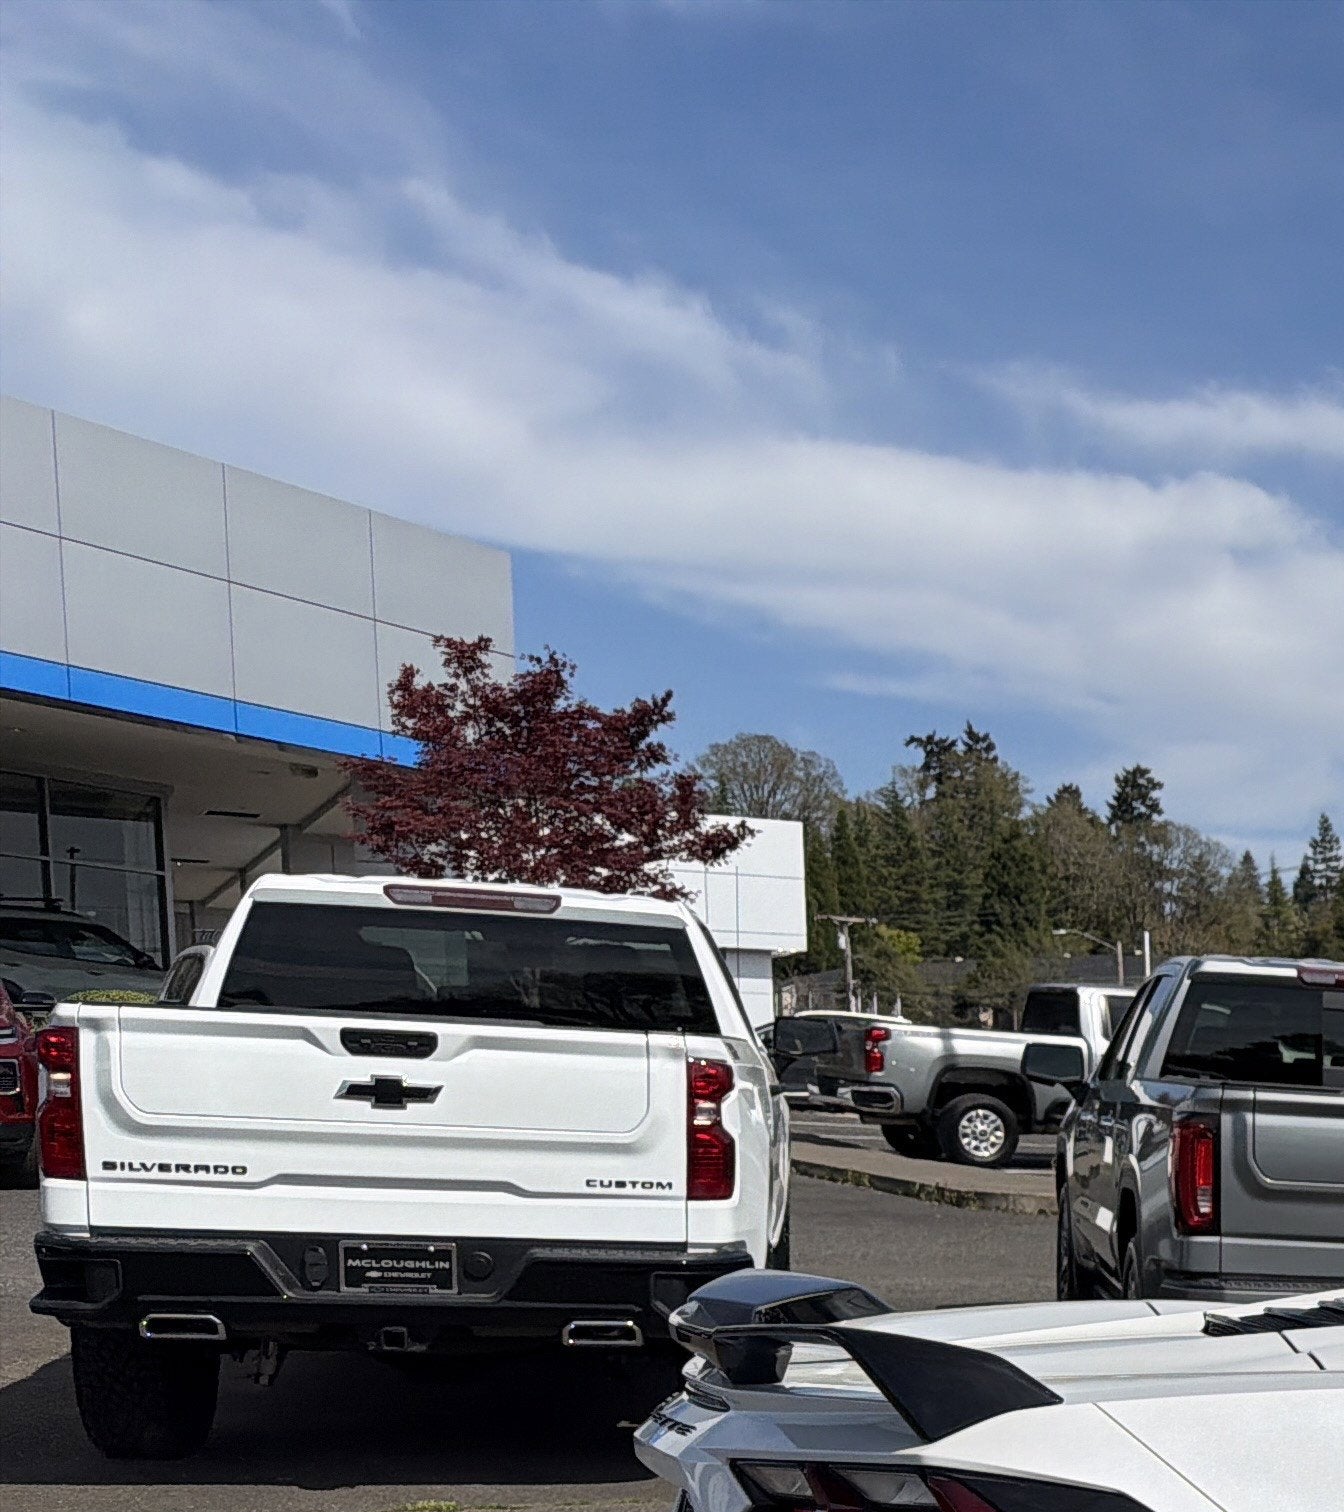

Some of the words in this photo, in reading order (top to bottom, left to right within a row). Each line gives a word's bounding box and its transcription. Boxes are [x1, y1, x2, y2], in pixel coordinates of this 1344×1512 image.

[101, 1160, 248, 1176] SILVERADO
[585, 1179, 673, 1191] CUSTOM
[347, 1258, 451, 1270] MCLOUGHLIN
[383, 1271, 433, 1279] CHEVROLET
